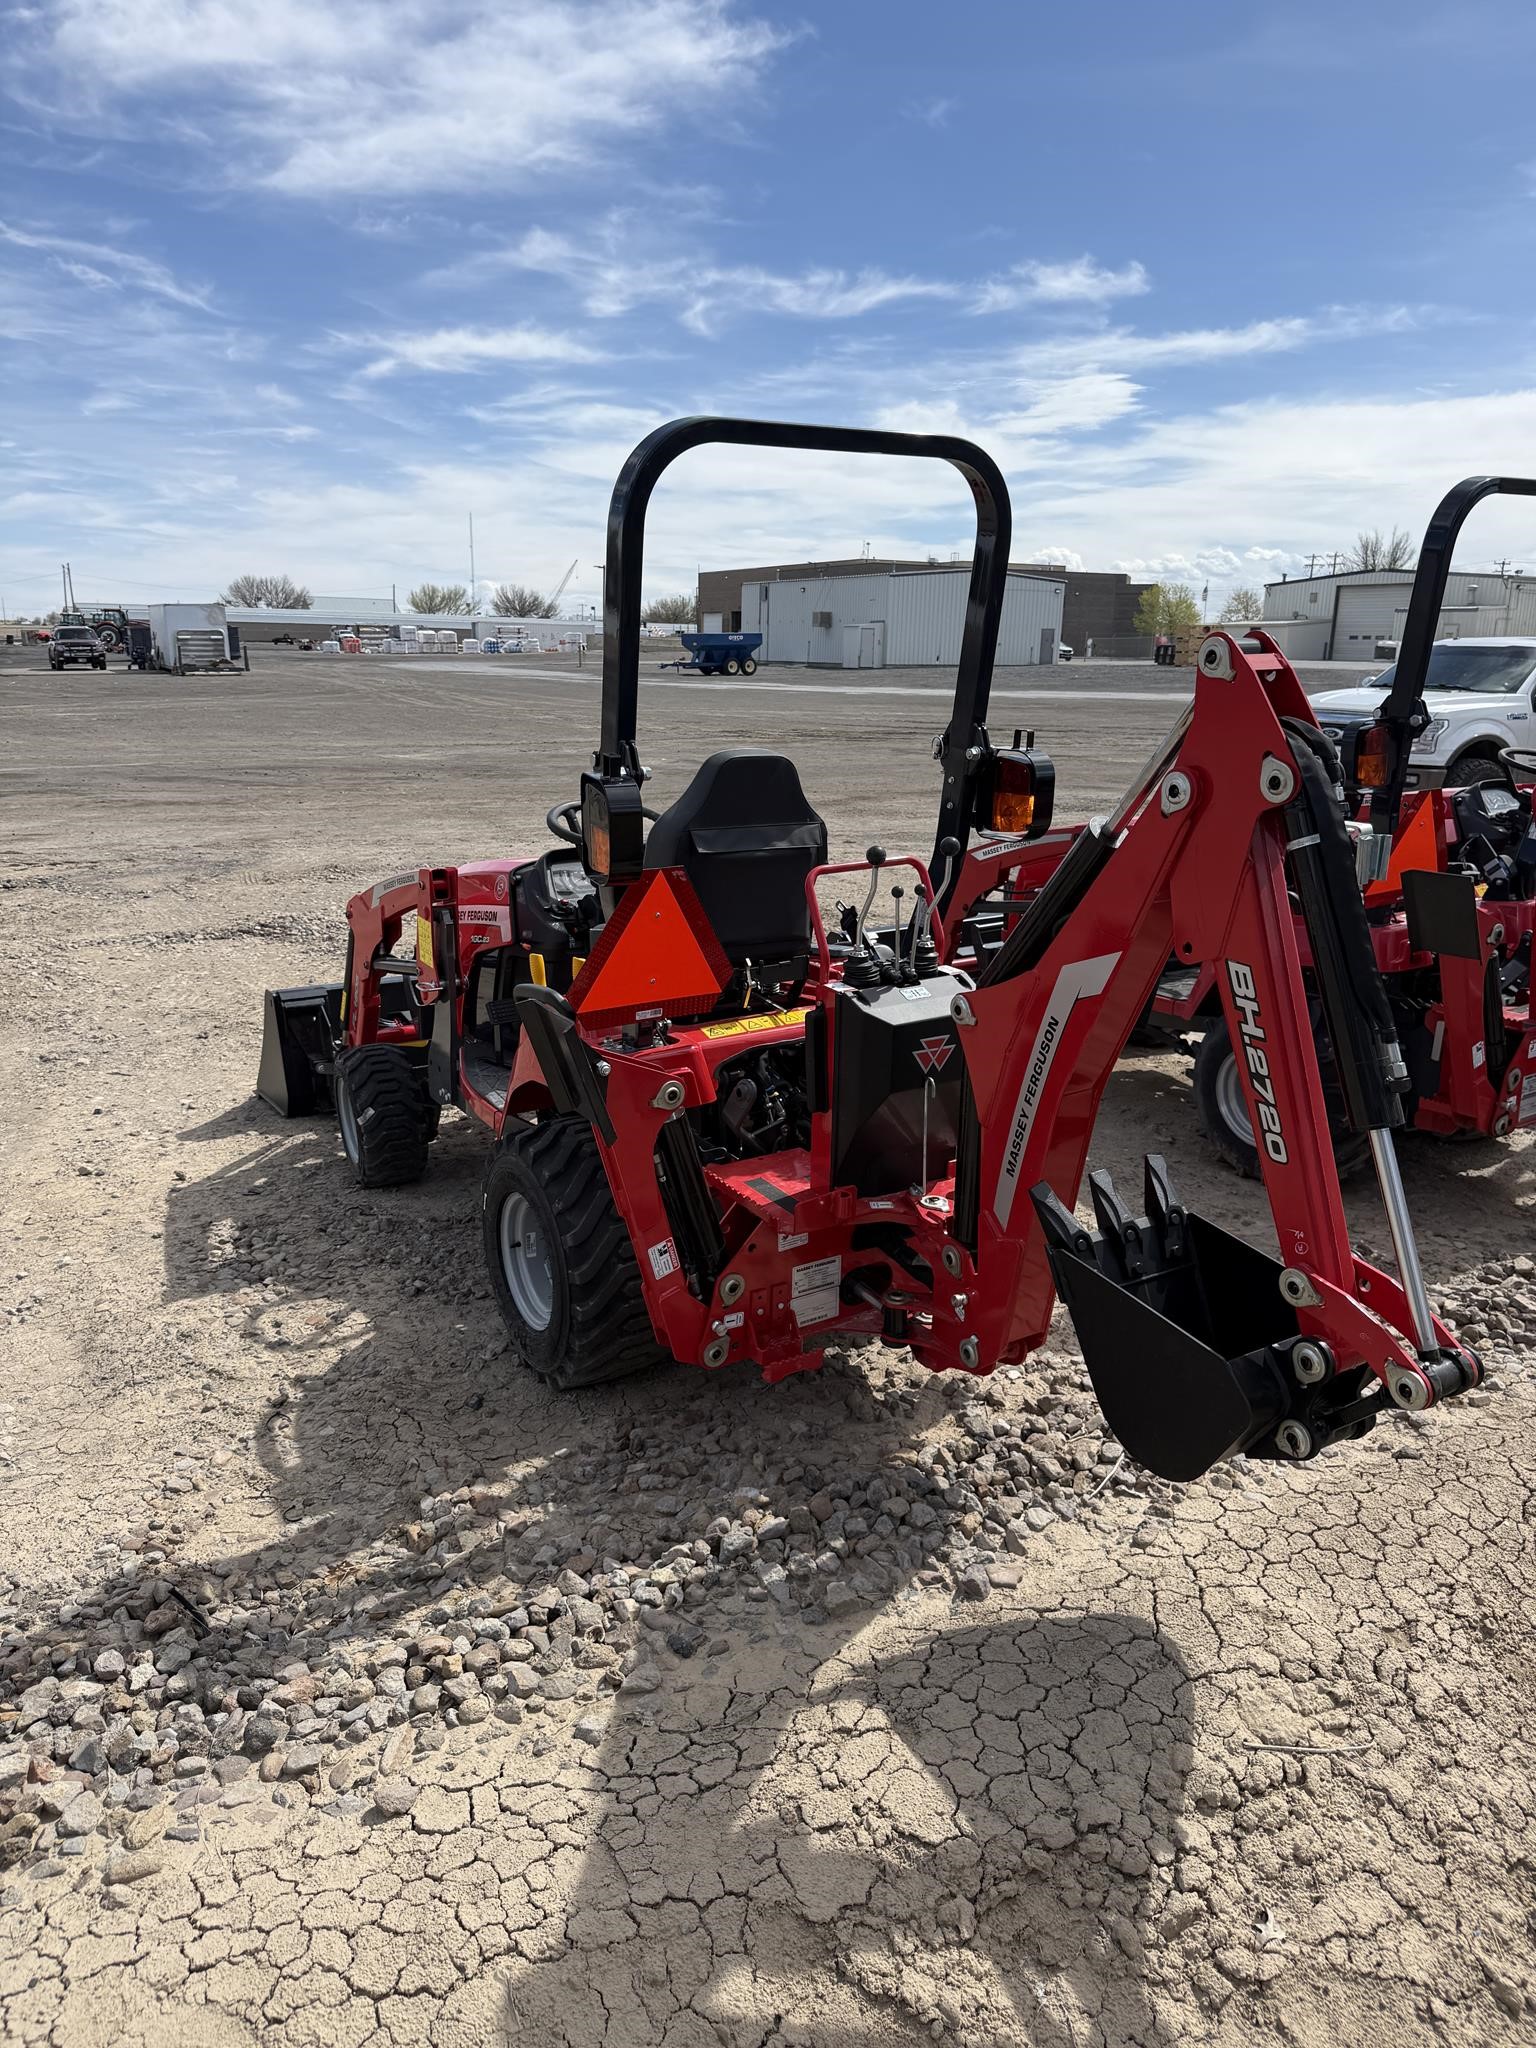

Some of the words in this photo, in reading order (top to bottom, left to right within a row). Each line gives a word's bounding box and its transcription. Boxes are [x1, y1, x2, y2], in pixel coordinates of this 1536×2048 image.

[982, 846, 1003, 856] MASSEY
[467, 911, 498, 921] FERGUSON
[1006, 1108, 1029, 1178] MASSEY
[1024, 1016, 1060, 1107] FERGUSON
[1226, 959, 1289, 1165] BH.2720
